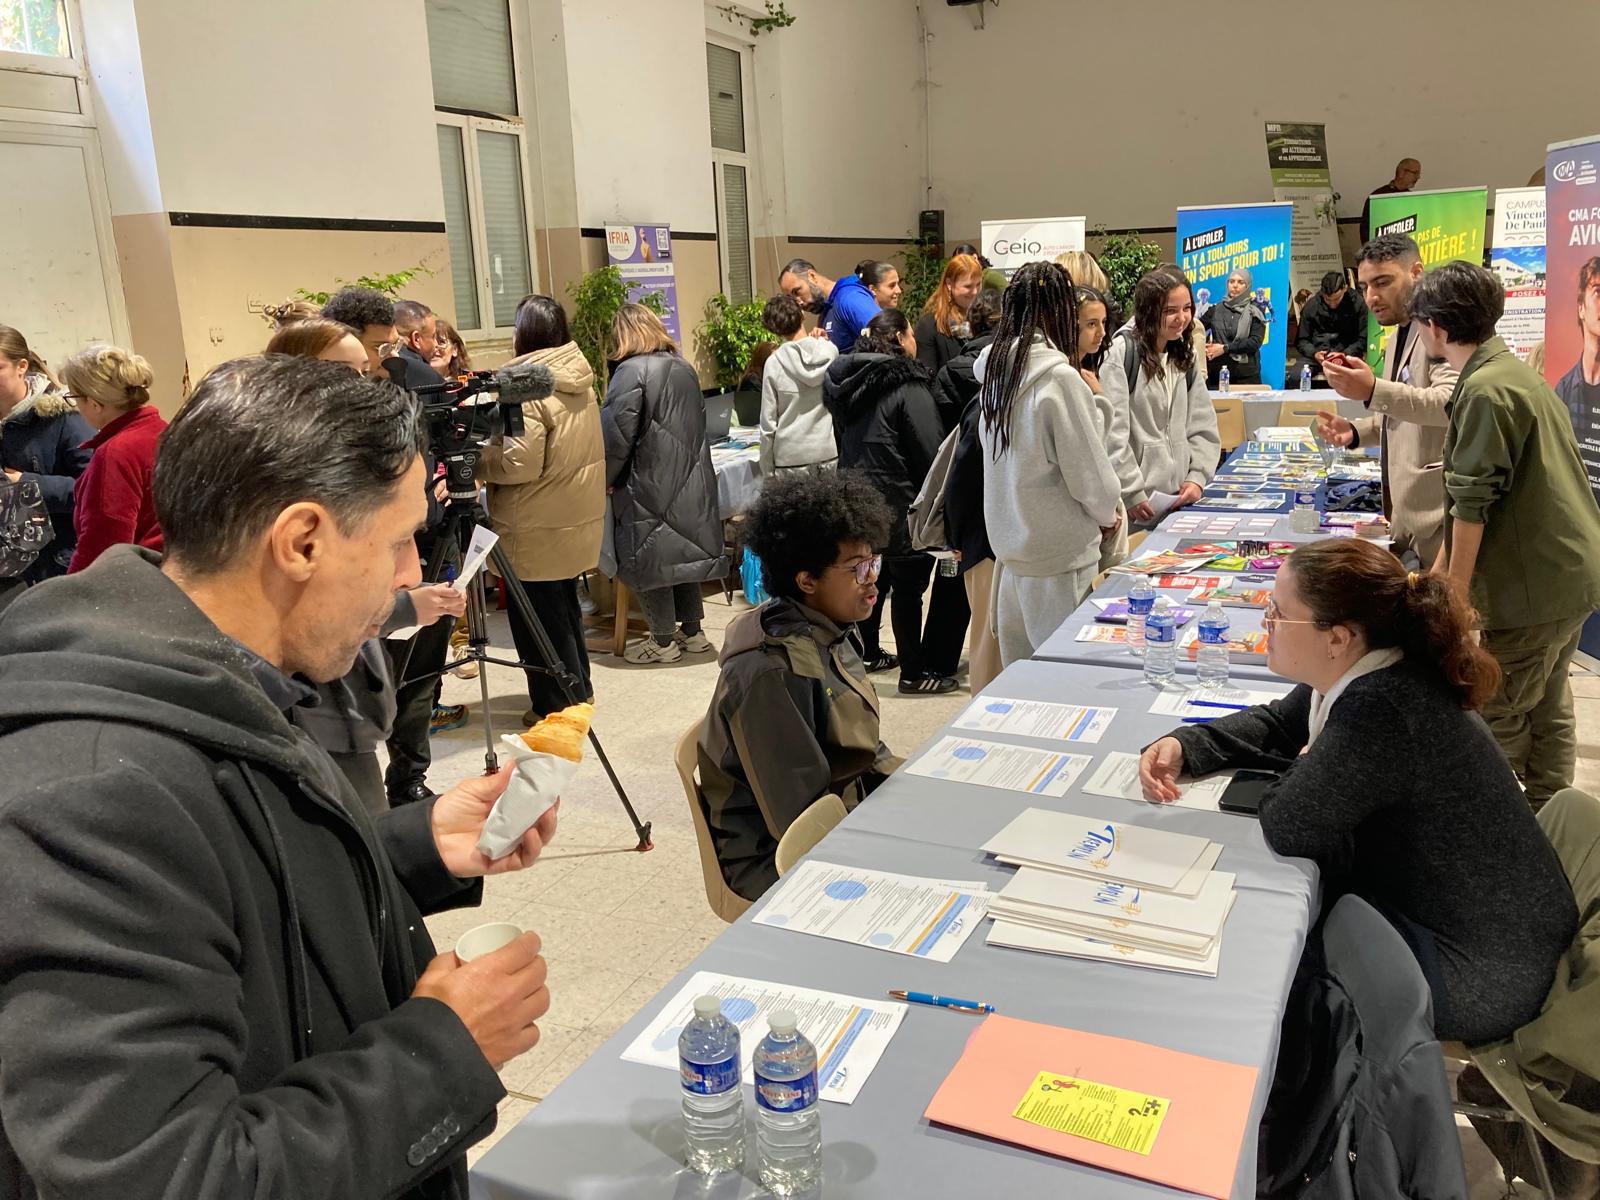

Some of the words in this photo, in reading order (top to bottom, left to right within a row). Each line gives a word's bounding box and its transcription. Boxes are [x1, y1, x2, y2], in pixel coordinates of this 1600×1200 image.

[1505, 221, 1520, 230] De
[1523, 219, 1546, 229] Paul
[1506, 210, 1546, 220] Vincent
[1568, 208, 1589, 222] CMA
[608, 231, 630, 245] IFRIA
[1185, 237, 1191, 251] À
[1192, 229, 1224, 250] L'UFOLEP,
[1417, 230, 1430, 243] PAS
[1432, 226, 1442, 237] DE
[1568, 224, 1600, 247] AVI
[1183, 257, 1190, 270] IL
[1192, 253, 1199, 267] Y
[1199, 252, 1205, 265] A
[1207, 238, 1249, 262] TOUJOURS
[1420, 232, 1468, 266] NTIÈRE
[1471, 228, 1477, 251] !
[1199, 258, 1230, 282] SPORT
[1232, 250, 1260, 272] POUR
[1262, 244, 1278, 263] TOI
